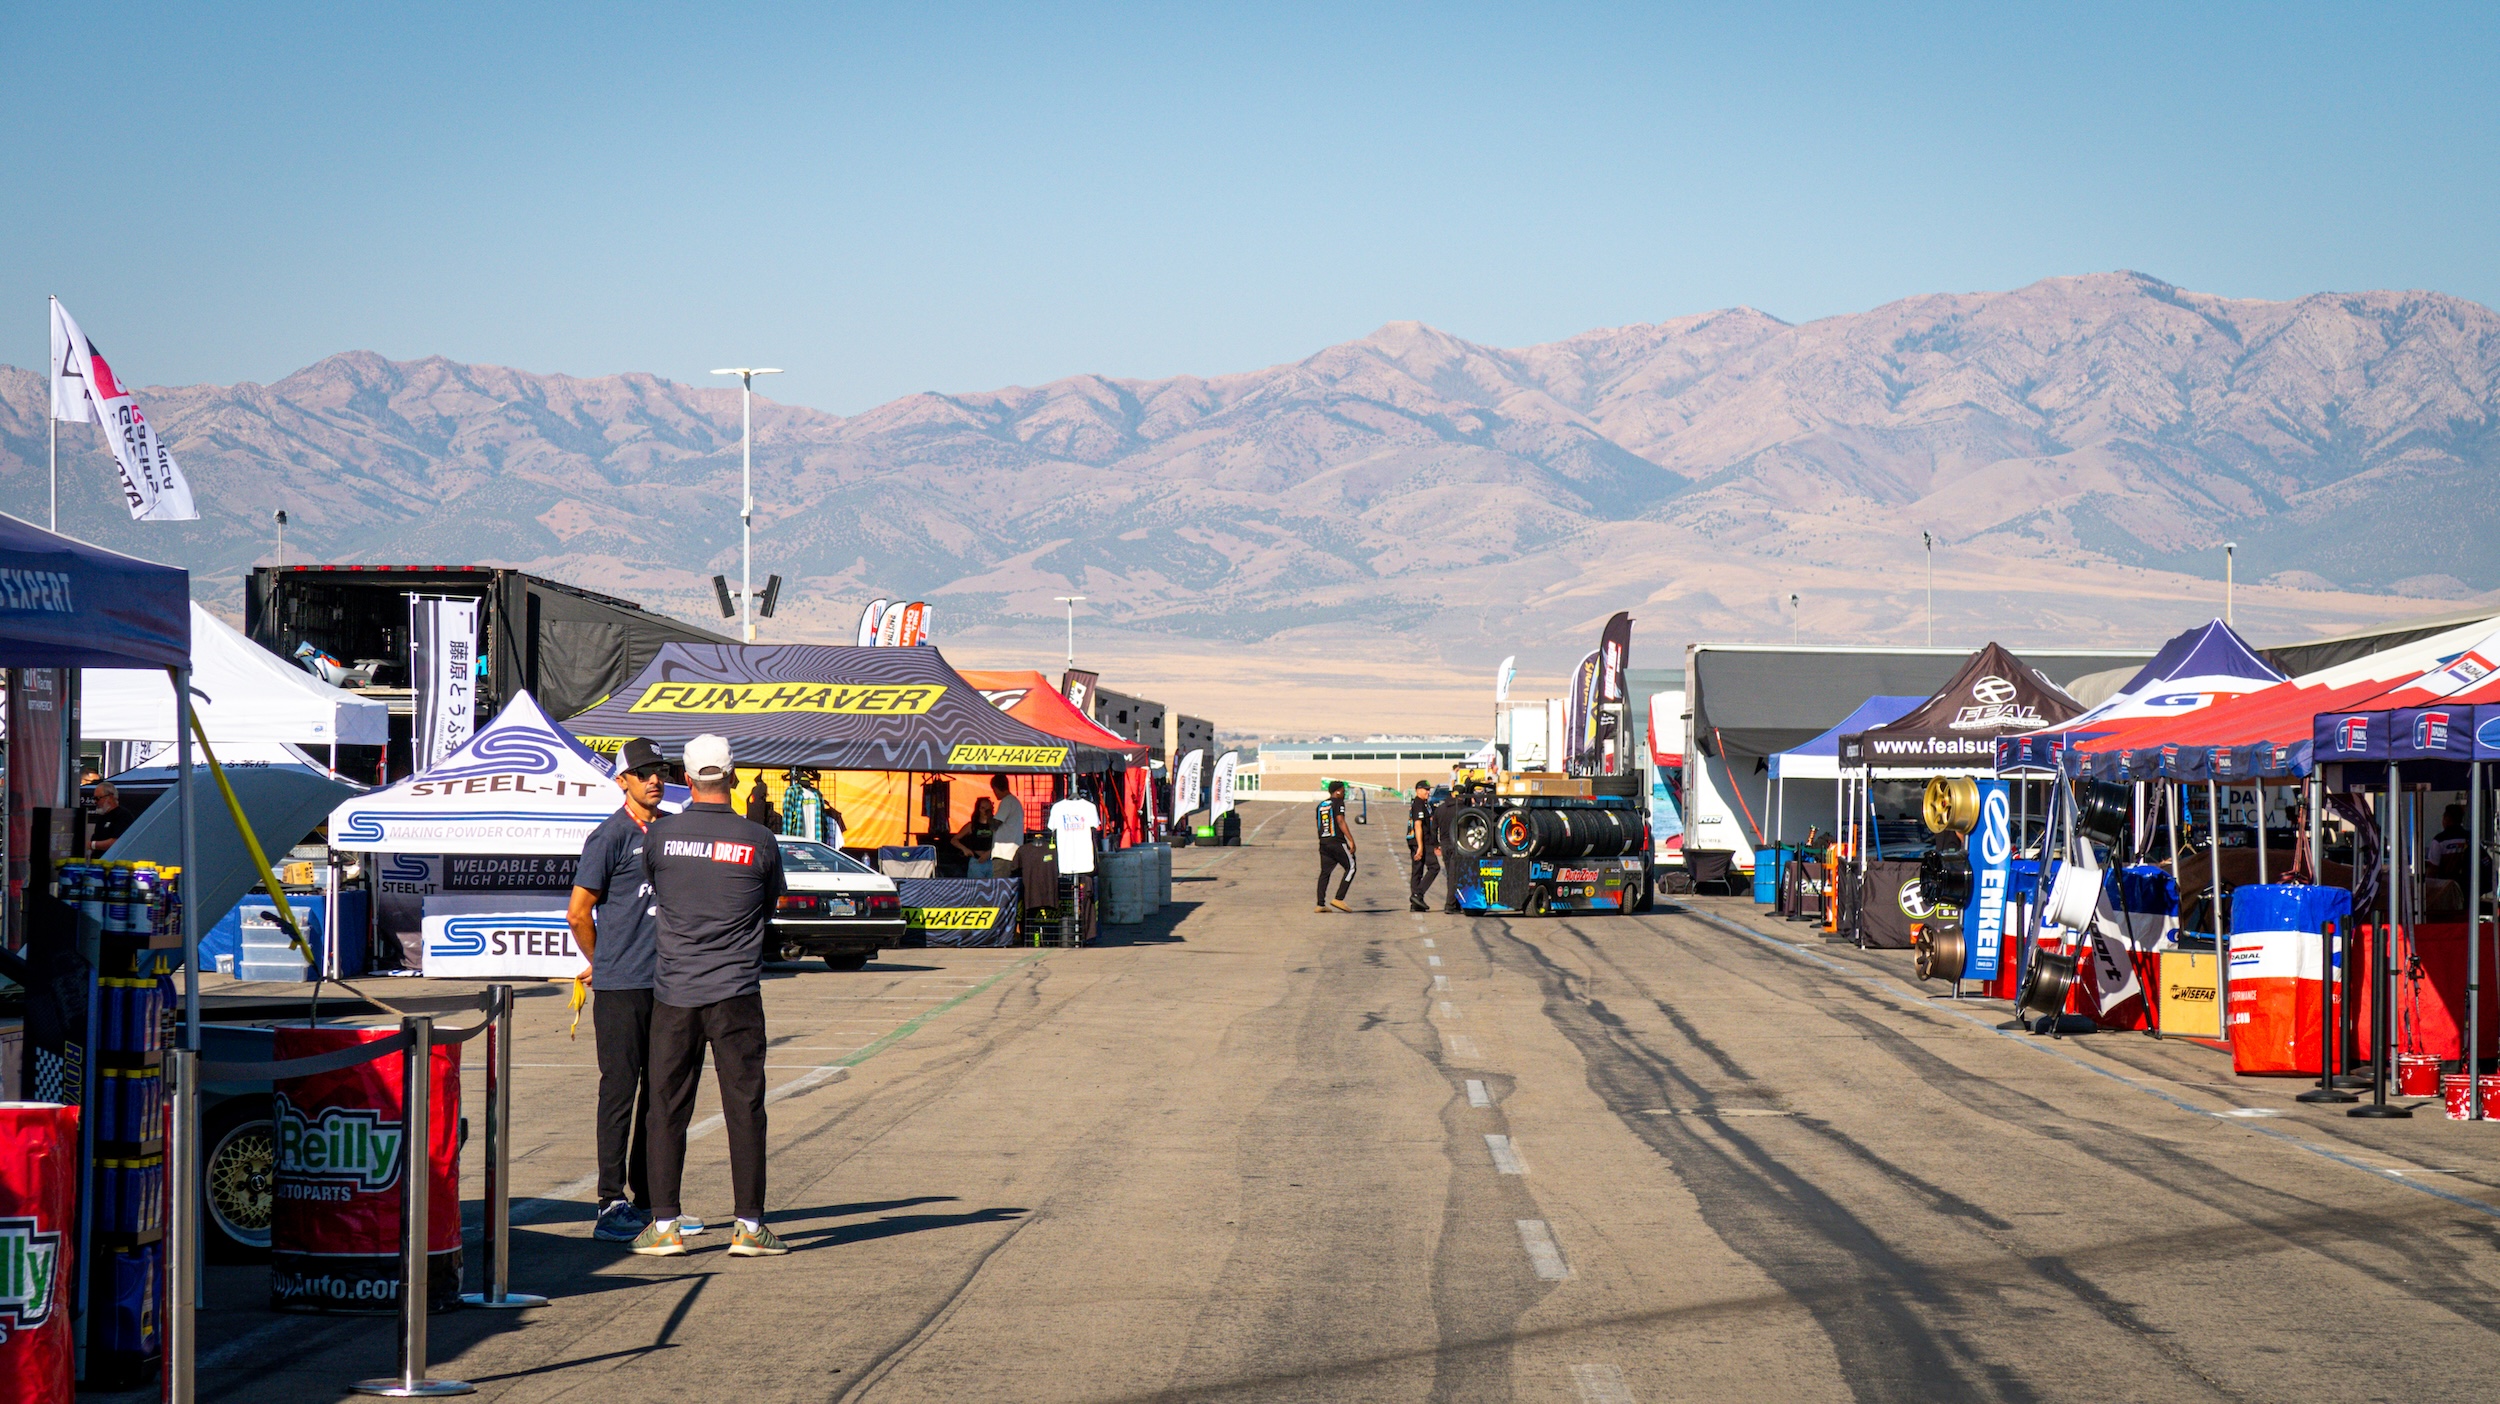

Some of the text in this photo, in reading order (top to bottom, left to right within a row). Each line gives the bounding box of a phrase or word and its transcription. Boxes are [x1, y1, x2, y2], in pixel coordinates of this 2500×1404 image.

[1, 568, 73, 613] EXPERT
[901, 609, 915, 646] UMHO
[642, 686, 932, 711] FUN-HAVER
[1954, 703, 2043, 722] FEAL
[583, 739, 631, 755] AVE
[953, 747, 1062, 763] FUN-HAVER
[410, 774, 597, 797] STEEL-IT
[389, 826, 444, 838] MAKING
[446, 826, 503, 838] POWDER
[506, 826, 540, 838] COAT
[542, 826, 552, 838] A
[664, 840, 712, 858] FORMULA
[714, 842, 752, 864] DRIFT
[453, 859, 539, 873] WELDABLE
[544, 859, 557, 873] &
[453, 874, 575, 886] HIGH PERFORM
[1565, 868, 1599, 882] AutoZone
[382, 881, 437, 895] STEEL-IT
[902, 910, 993, 927] N-HAVER
[1976, 869, 2007, 957] ENKEI
[491, 931, 577, 957] STEEL
[2180, 987, 2216, 1001] WISEFAB
[2229, 990, 2257, 1003] FORMANCE
